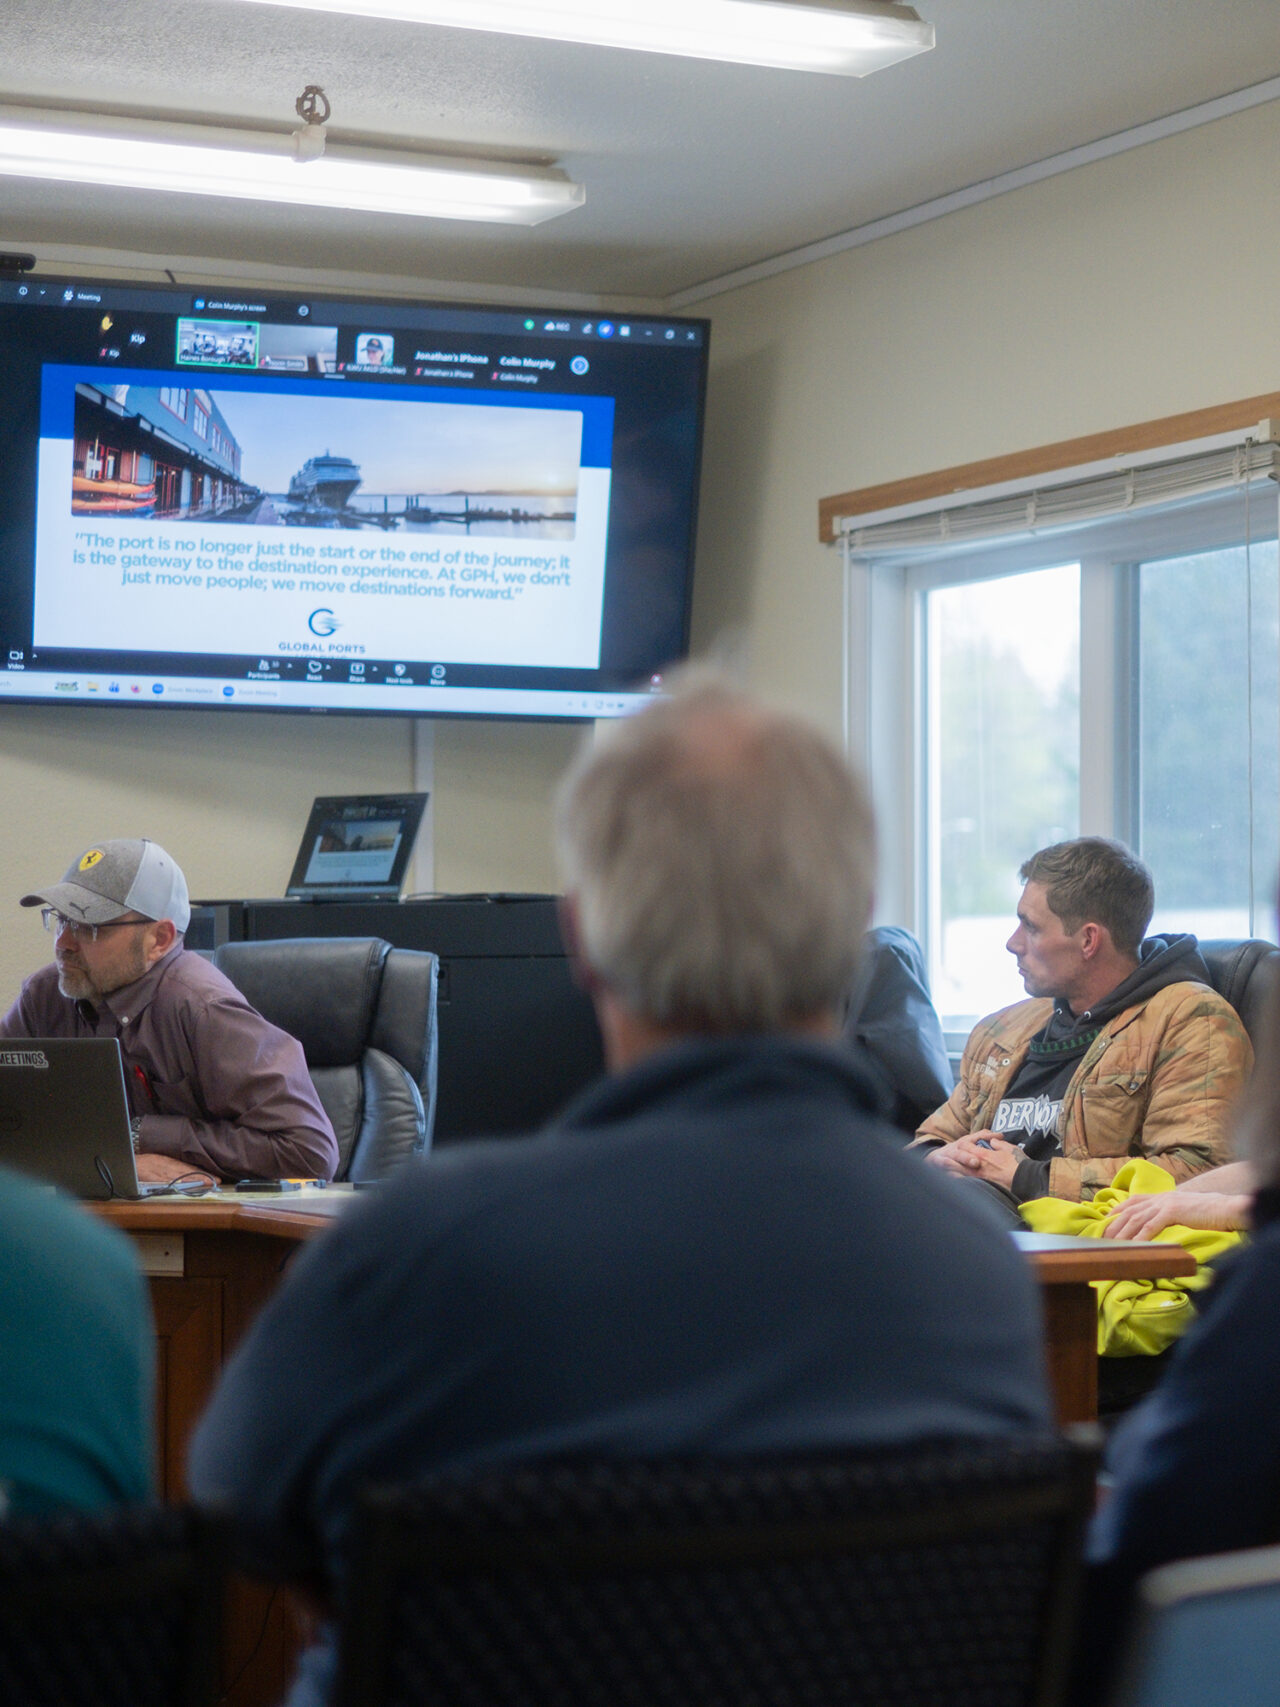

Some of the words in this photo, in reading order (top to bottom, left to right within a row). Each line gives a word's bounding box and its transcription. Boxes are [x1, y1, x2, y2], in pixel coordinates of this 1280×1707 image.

[73, 550, 86, 564] is
[89, 551, 117, 565] the
[120, 554, 192, 571] gateway
[196, 557, 214, 570] to
[217, 557, 244, 571] the
[247, 558, 338, 576] destination
[341, 563, 433, 580] experience.
[436, 567, 456, 581] At
[459, 568, 500, 584] GPH,
[502, 572, 527, 584] we
[529, 571, 571, 586] don't
[119, 536, 154, 551] port
[158, 536, 171, 550] is
[174, 539, 196, 551] no
[200, 538, 253, 556] longer
[255, 541, 285, 558] just
[289, 542, 316, 557] the
[319, 544, 355, 559] start
[359, 549, 376, 560] or
[380, 547, 406, 562] the
[409, 549, 441, 564] end
[443, 550, 461, 564] of
[463, 551, 490, 565] the
[492, 552, 556, 571] journey;
[559, 554, 570, 569] it
[121, 569, 151, 586] just
[155, 573, 202, 585] move
[205, 575, 268, 591] people;
[271, 578, 296, 590] we
[299, 579, 346, 593] move
[349, 579, 446, 597] destinations
[278, 641, 325, 652] GLOBAL
[328, 643, 366, 654] PORTS
